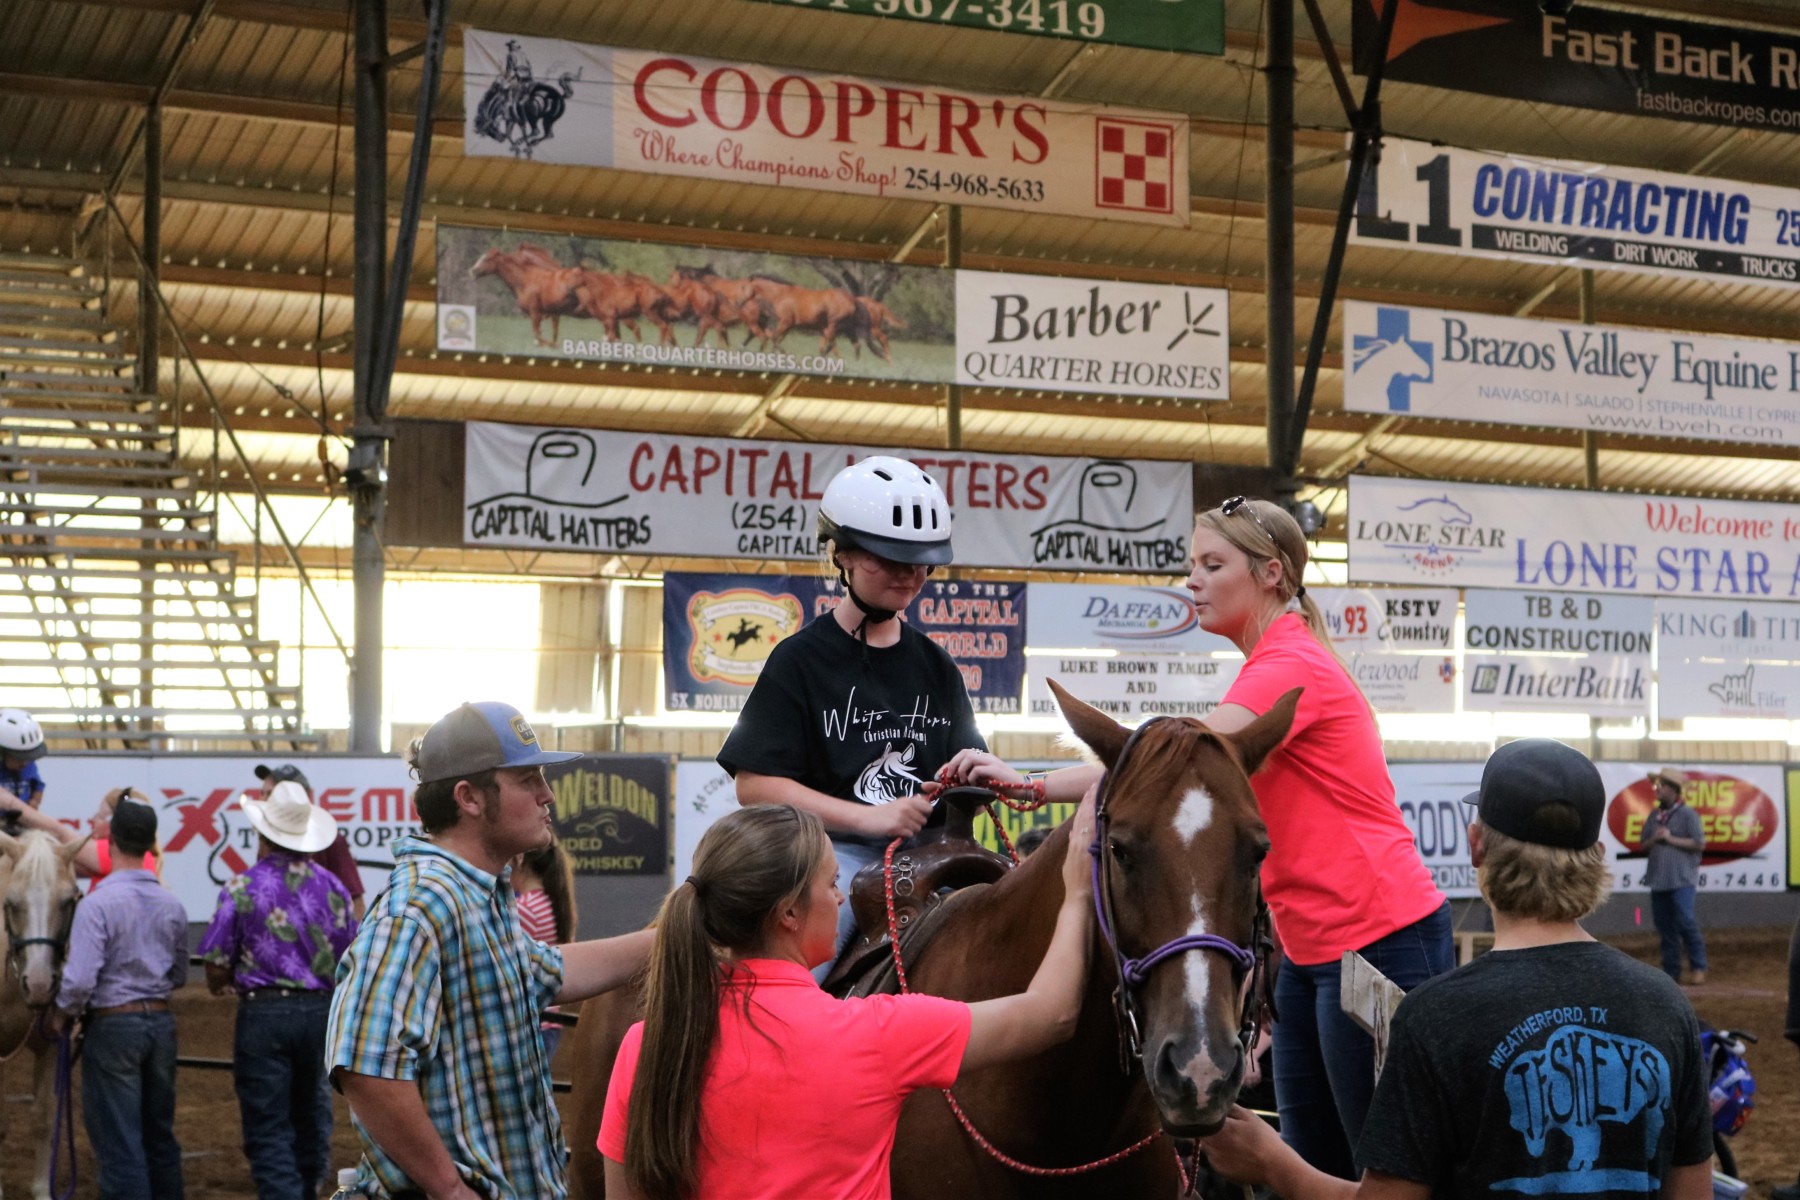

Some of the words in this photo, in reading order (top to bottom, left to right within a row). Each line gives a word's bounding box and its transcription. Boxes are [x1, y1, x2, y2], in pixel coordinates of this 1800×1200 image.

[1541, 14, 1639, 70] Fast
[1654, 31, 1756, 85] Back
[1770, 46, 1800, 90] R
[633, 58, 1051, 165] COOPER'S
[633, 127, 713, 167] Where
[715, 138, 831, 185] Champions
[836, 150, 897, 197] Shop!
[904, 166, 1045, 202] 254-968-5633
[1472, 163, 1751, 246] CONTRACTING
[1495, 230, 1569, 256] WELDING
[1613, 242, 1647, 264] DIRT
[1652, 246, 1699, 270] WORK
[1740, 255, 1797, 280] TRUCKS
[987, 286, 1162, 344] Barber
[963, 350, 1102, 384] QUARTER
[1110, 361, 1222, 391] HORSES
[1441, 317, 1556, 373] Brazos
[1558, 328, 1660, 393] Valley
[1671, 340, 1778, 401] Equine
[1478, 384, 1562, 406] NAVASOTA
[1575, 392, 1635, 412] SALADO
[1647, 399, 1744, 420] STEPHENVILLE
[1586, 413, 1784, 440] www.bveh.com
[629, 441, 824, 501] CAPITAL
[471, 504, 556, 542] CAPITAL
[560, 513, 652, 549] HATTERS
[731, 502, 807, 532] (254)
[1645, 501, 1774, 541] Welcome
[1033, 529, 1105, 564] CAPITAL
[1108, 536, 1187, 568] HATTERS
[1355, 519, 1432, 545] LONE
[1438, 525, 1506, 549] STAR
[1413, 551, 1454, 570] ARENA
[1514, 537, 1639, 590] LONE
[1656, 546, 1773, 596] STAR
[934, 583, 960, 596] TO
[972, 583, 1010, 597] THE
[918, 597, 1020, 627] CAPITAL
[1344, 605, 1368, 635] 93
[1385, 599, 1442, 617] KSTV
[1523, 595, 1553, 618] TB
[1560, 597, 1579, 620] &
[1586, 598, 1603, 620] D
[1377, 618, 1450, 647] Country
[1466, 625, 1652, 654] CONSTRUCTION
[1660, 612, 1728, 638] KING
[1060, 660, 1099, 675] LUKE
[1106, 661, 1159, 675] BROWN
[1167, 661, 1220, 676] FAMILY
[1349, 653, 1424, 681] lewood
[1502, 663, 1649, 700] InterBank
[1126, 681, 1158, 694] AND
[984, 696, 1019, 713] YEAR
[551, 768, 658, 828] WELDON
[1590, 1006, 1609, 1025] TX
